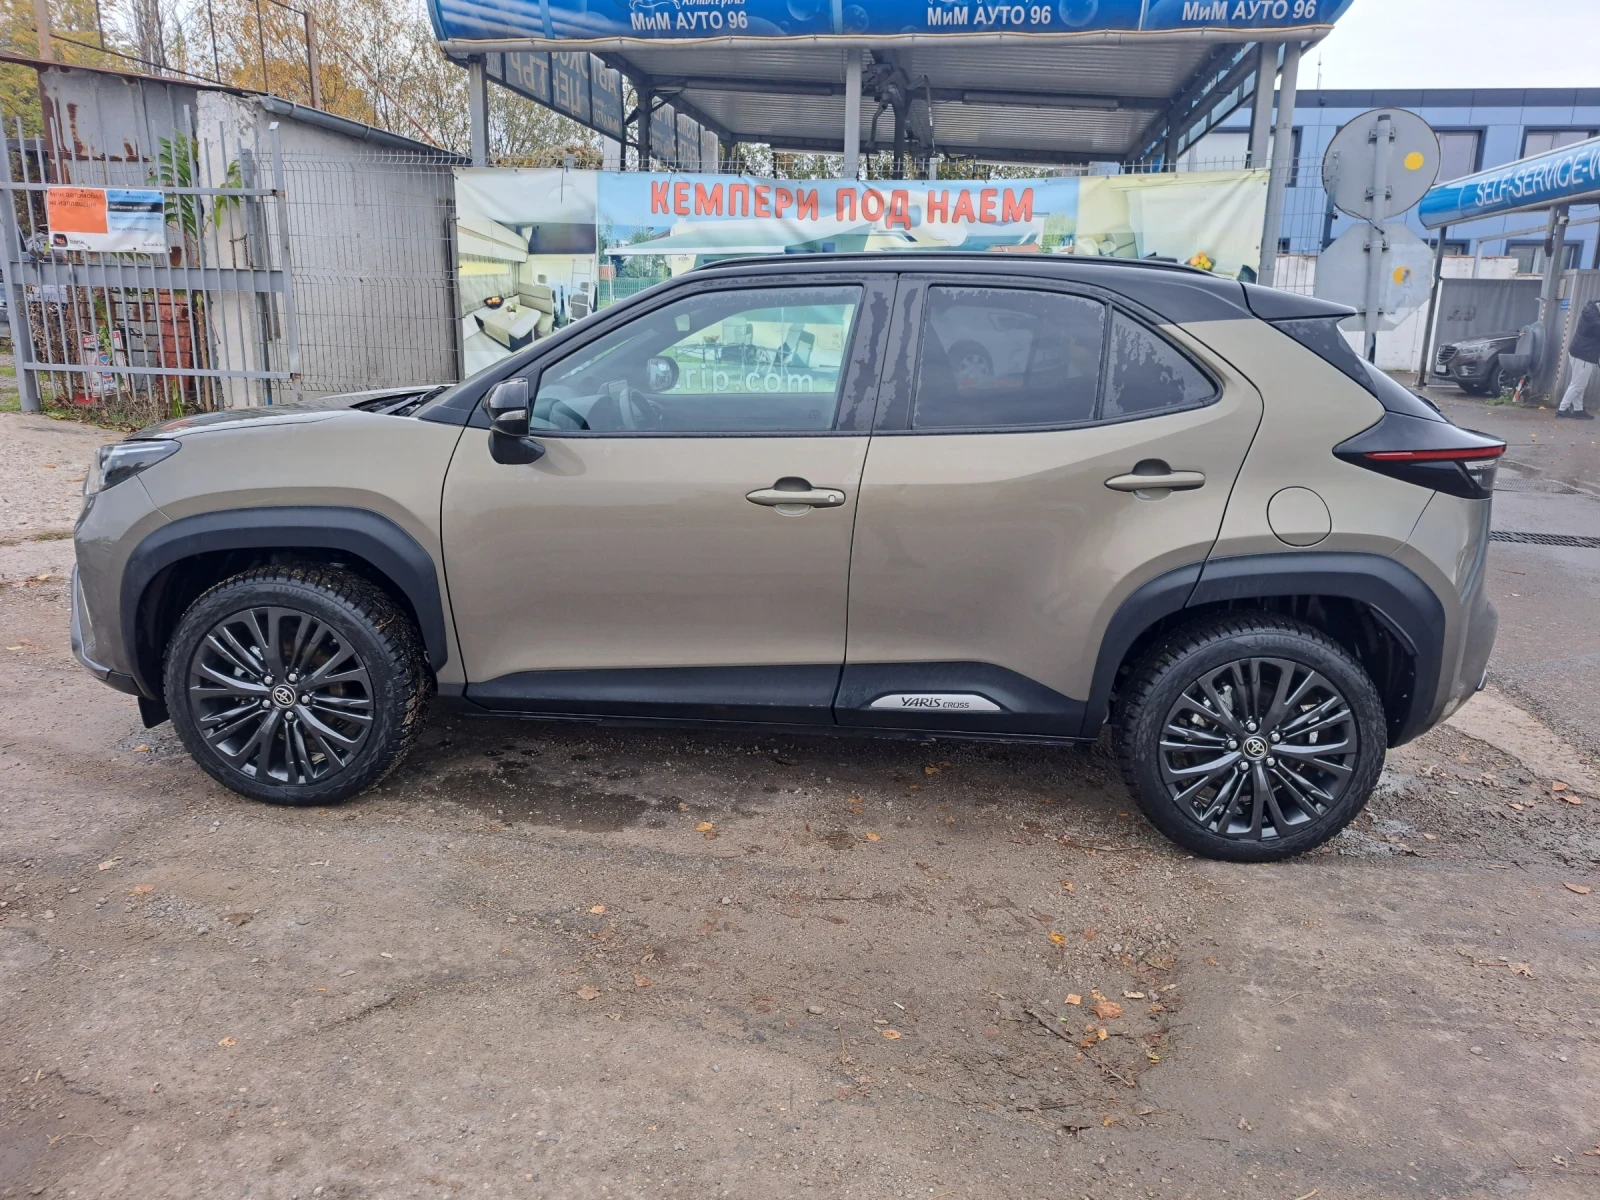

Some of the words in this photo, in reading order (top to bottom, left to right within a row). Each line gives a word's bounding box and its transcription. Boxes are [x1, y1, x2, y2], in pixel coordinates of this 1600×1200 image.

[630, 12, 671, 31] МиМ
[676, 10, 724, 30] АУТО
[727, 10, 749, 29] 96
[927, 6, 969, 26] МиМ
[973, 5, 1026, 25] АУТО
[1030, 5, 1052, 25] 96
[1182, 1, 1228, 21] МиМ
[1231, 0, 1289, 20] АУТО
[1292, 0, 1317, 19] 96
[651, 180, 819, 221] КЕМПЕРИ
[836, 187, 911, 230] ПОД
[927, 187, 1034, 223] НАЕМ
[674, 363, 814, 393] rip.com
[942, 701, 970, 709] CROSS
